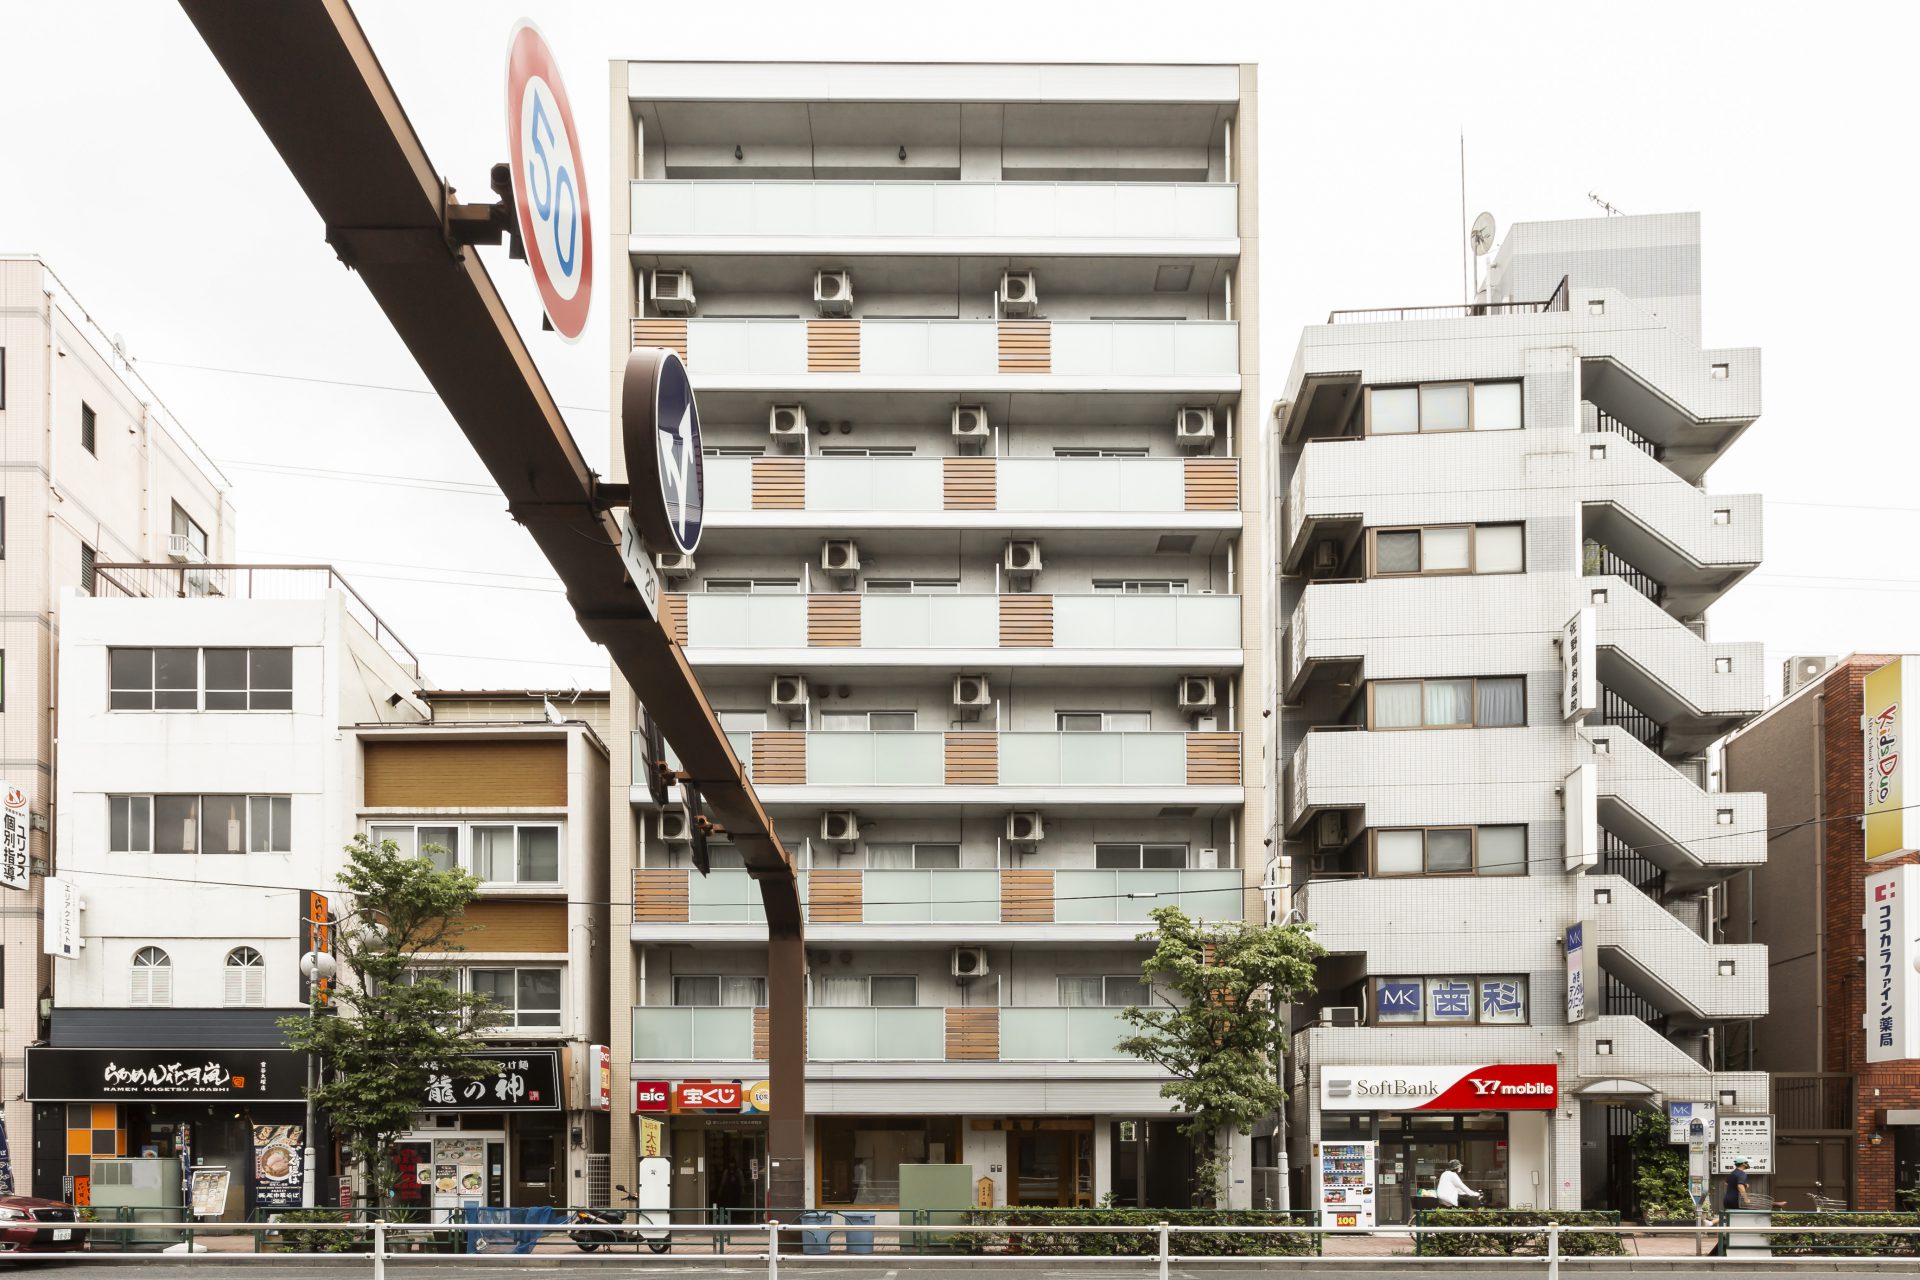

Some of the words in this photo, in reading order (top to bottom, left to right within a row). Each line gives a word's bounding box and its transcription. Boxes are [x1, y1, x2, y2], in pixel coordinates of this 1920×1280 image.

[529, 87, 577, 278] 50
[4, 813, 16, 882] 個別指導
[17, 825, 27, 880] ユリウス
[64, 884, 72, 943] エリアクエスト
[1569, 930, 1582, 946] MK
[1879, 905, 1893, 1047] ココカラファイン薬局
[1383, 989, 1417, 1006] MK
[1432, 981, 1522, 1018] 歯科
[423, 1073, 525, 1104] 龍の神
[683, 1088, 735, 1104] 宝くじ
[1357, 1079, 1440, 1096] SoftBank
[1673, 1106, 1690, 1115] MK
